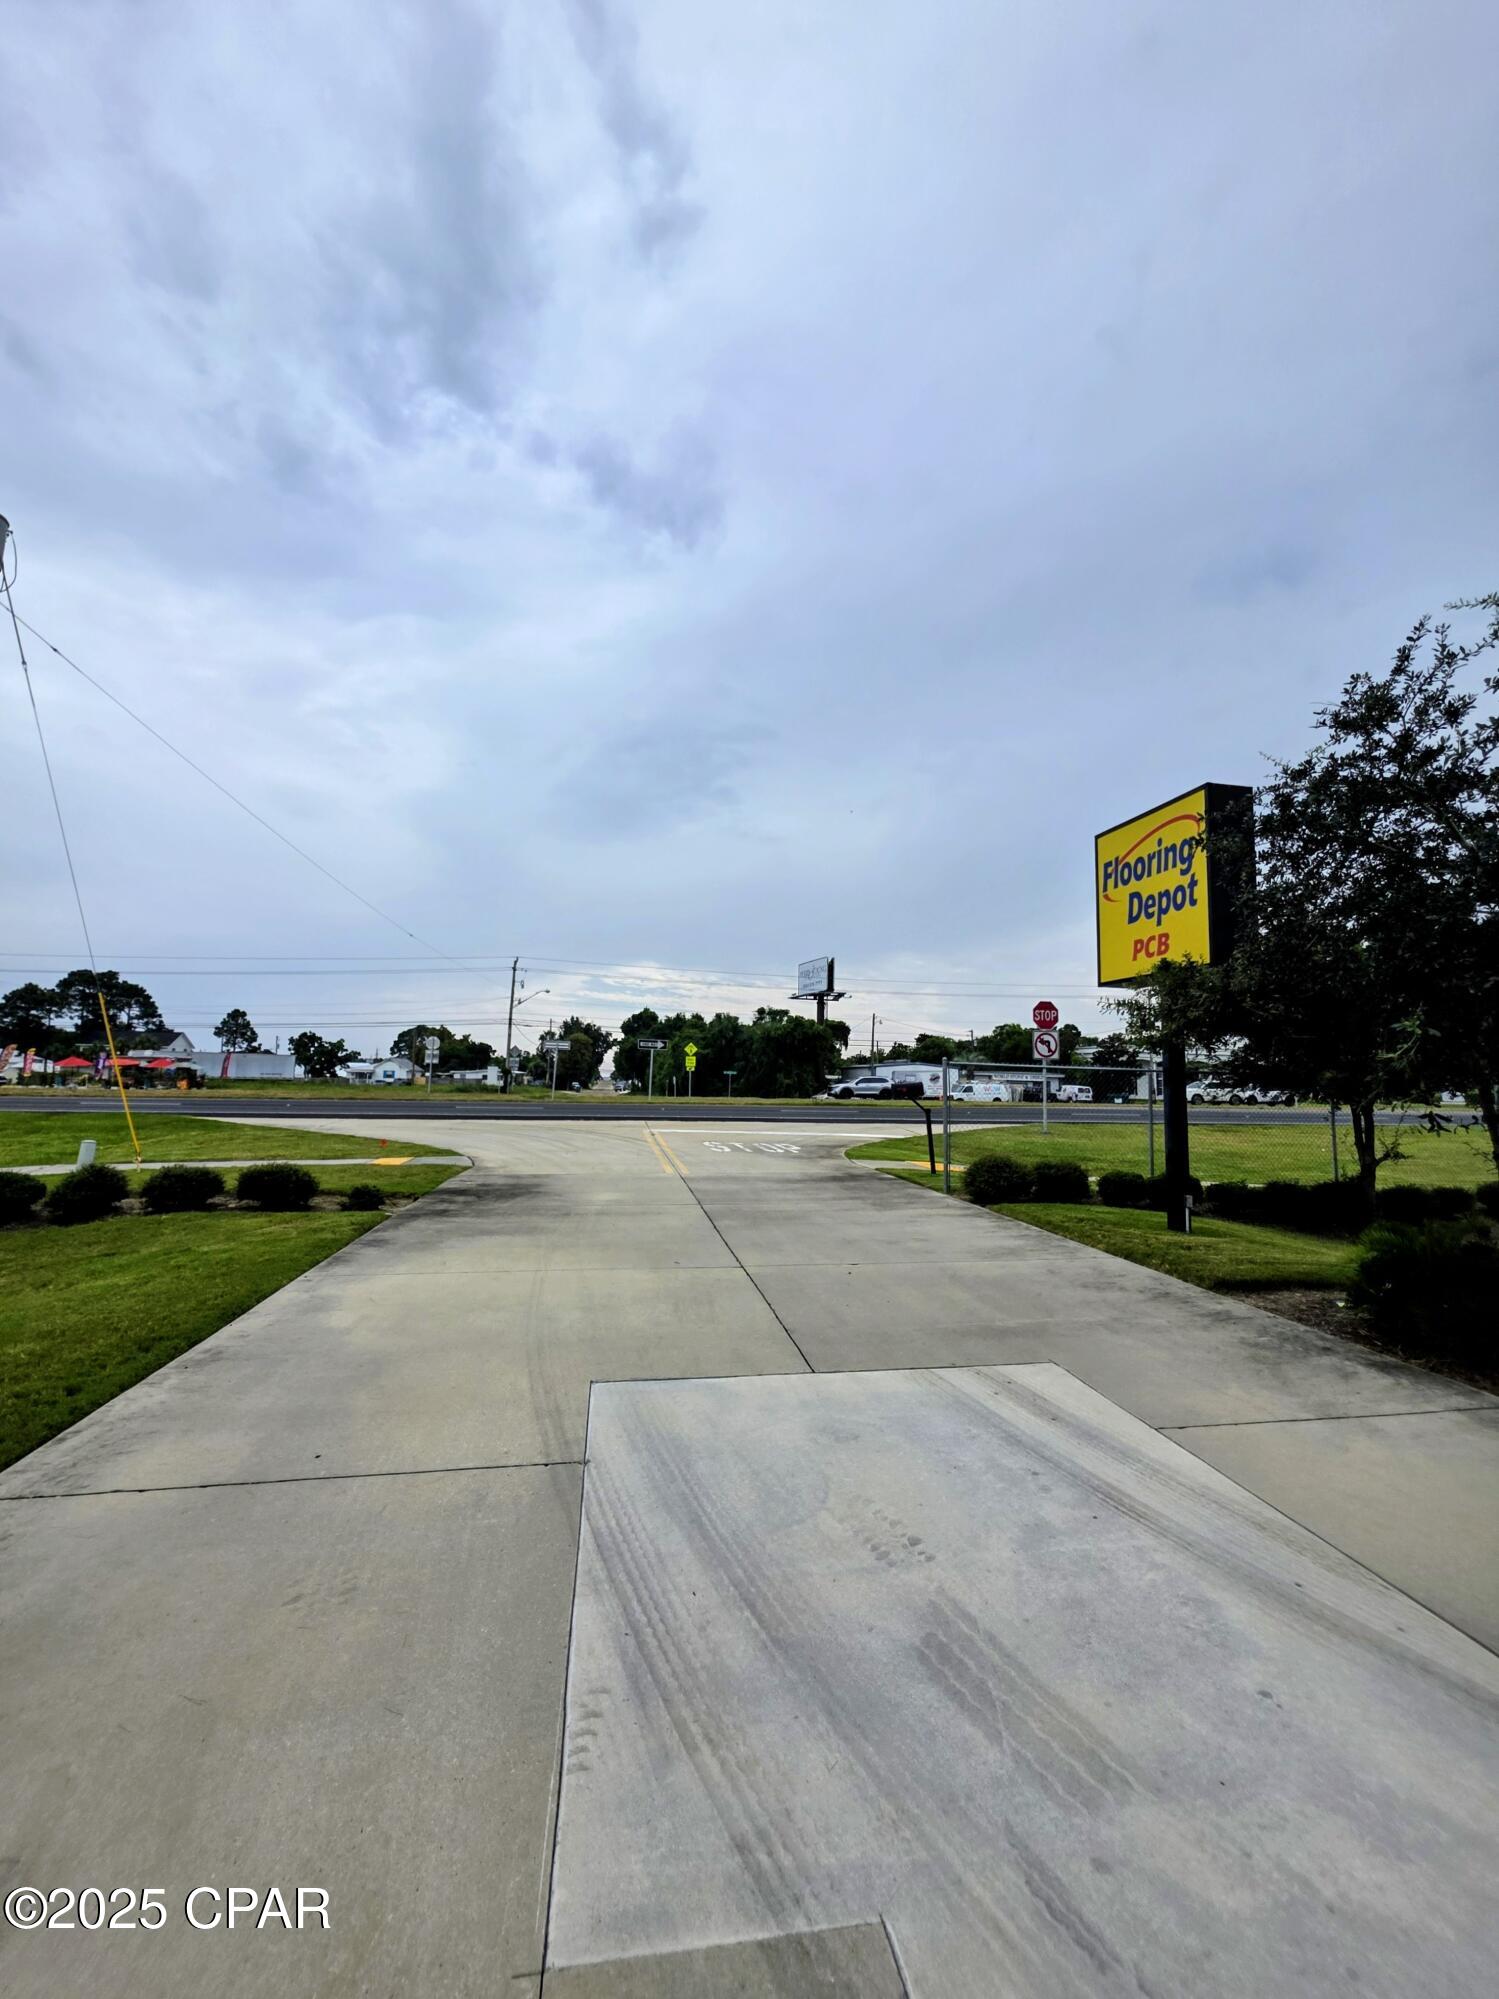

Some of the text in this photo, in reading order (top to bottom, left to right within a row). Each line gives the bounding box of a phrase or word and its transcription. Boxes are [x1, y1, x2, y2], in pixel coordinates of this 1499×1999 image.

[1102, 837, 1196, 893] Flooring
[1127, 872, 1198, 927] Depot
[1132, 932, 1170, 961] PCB
[1034, 1010, 1057, 1021] STOP
[702, 1141, 801, 1154] STOP
